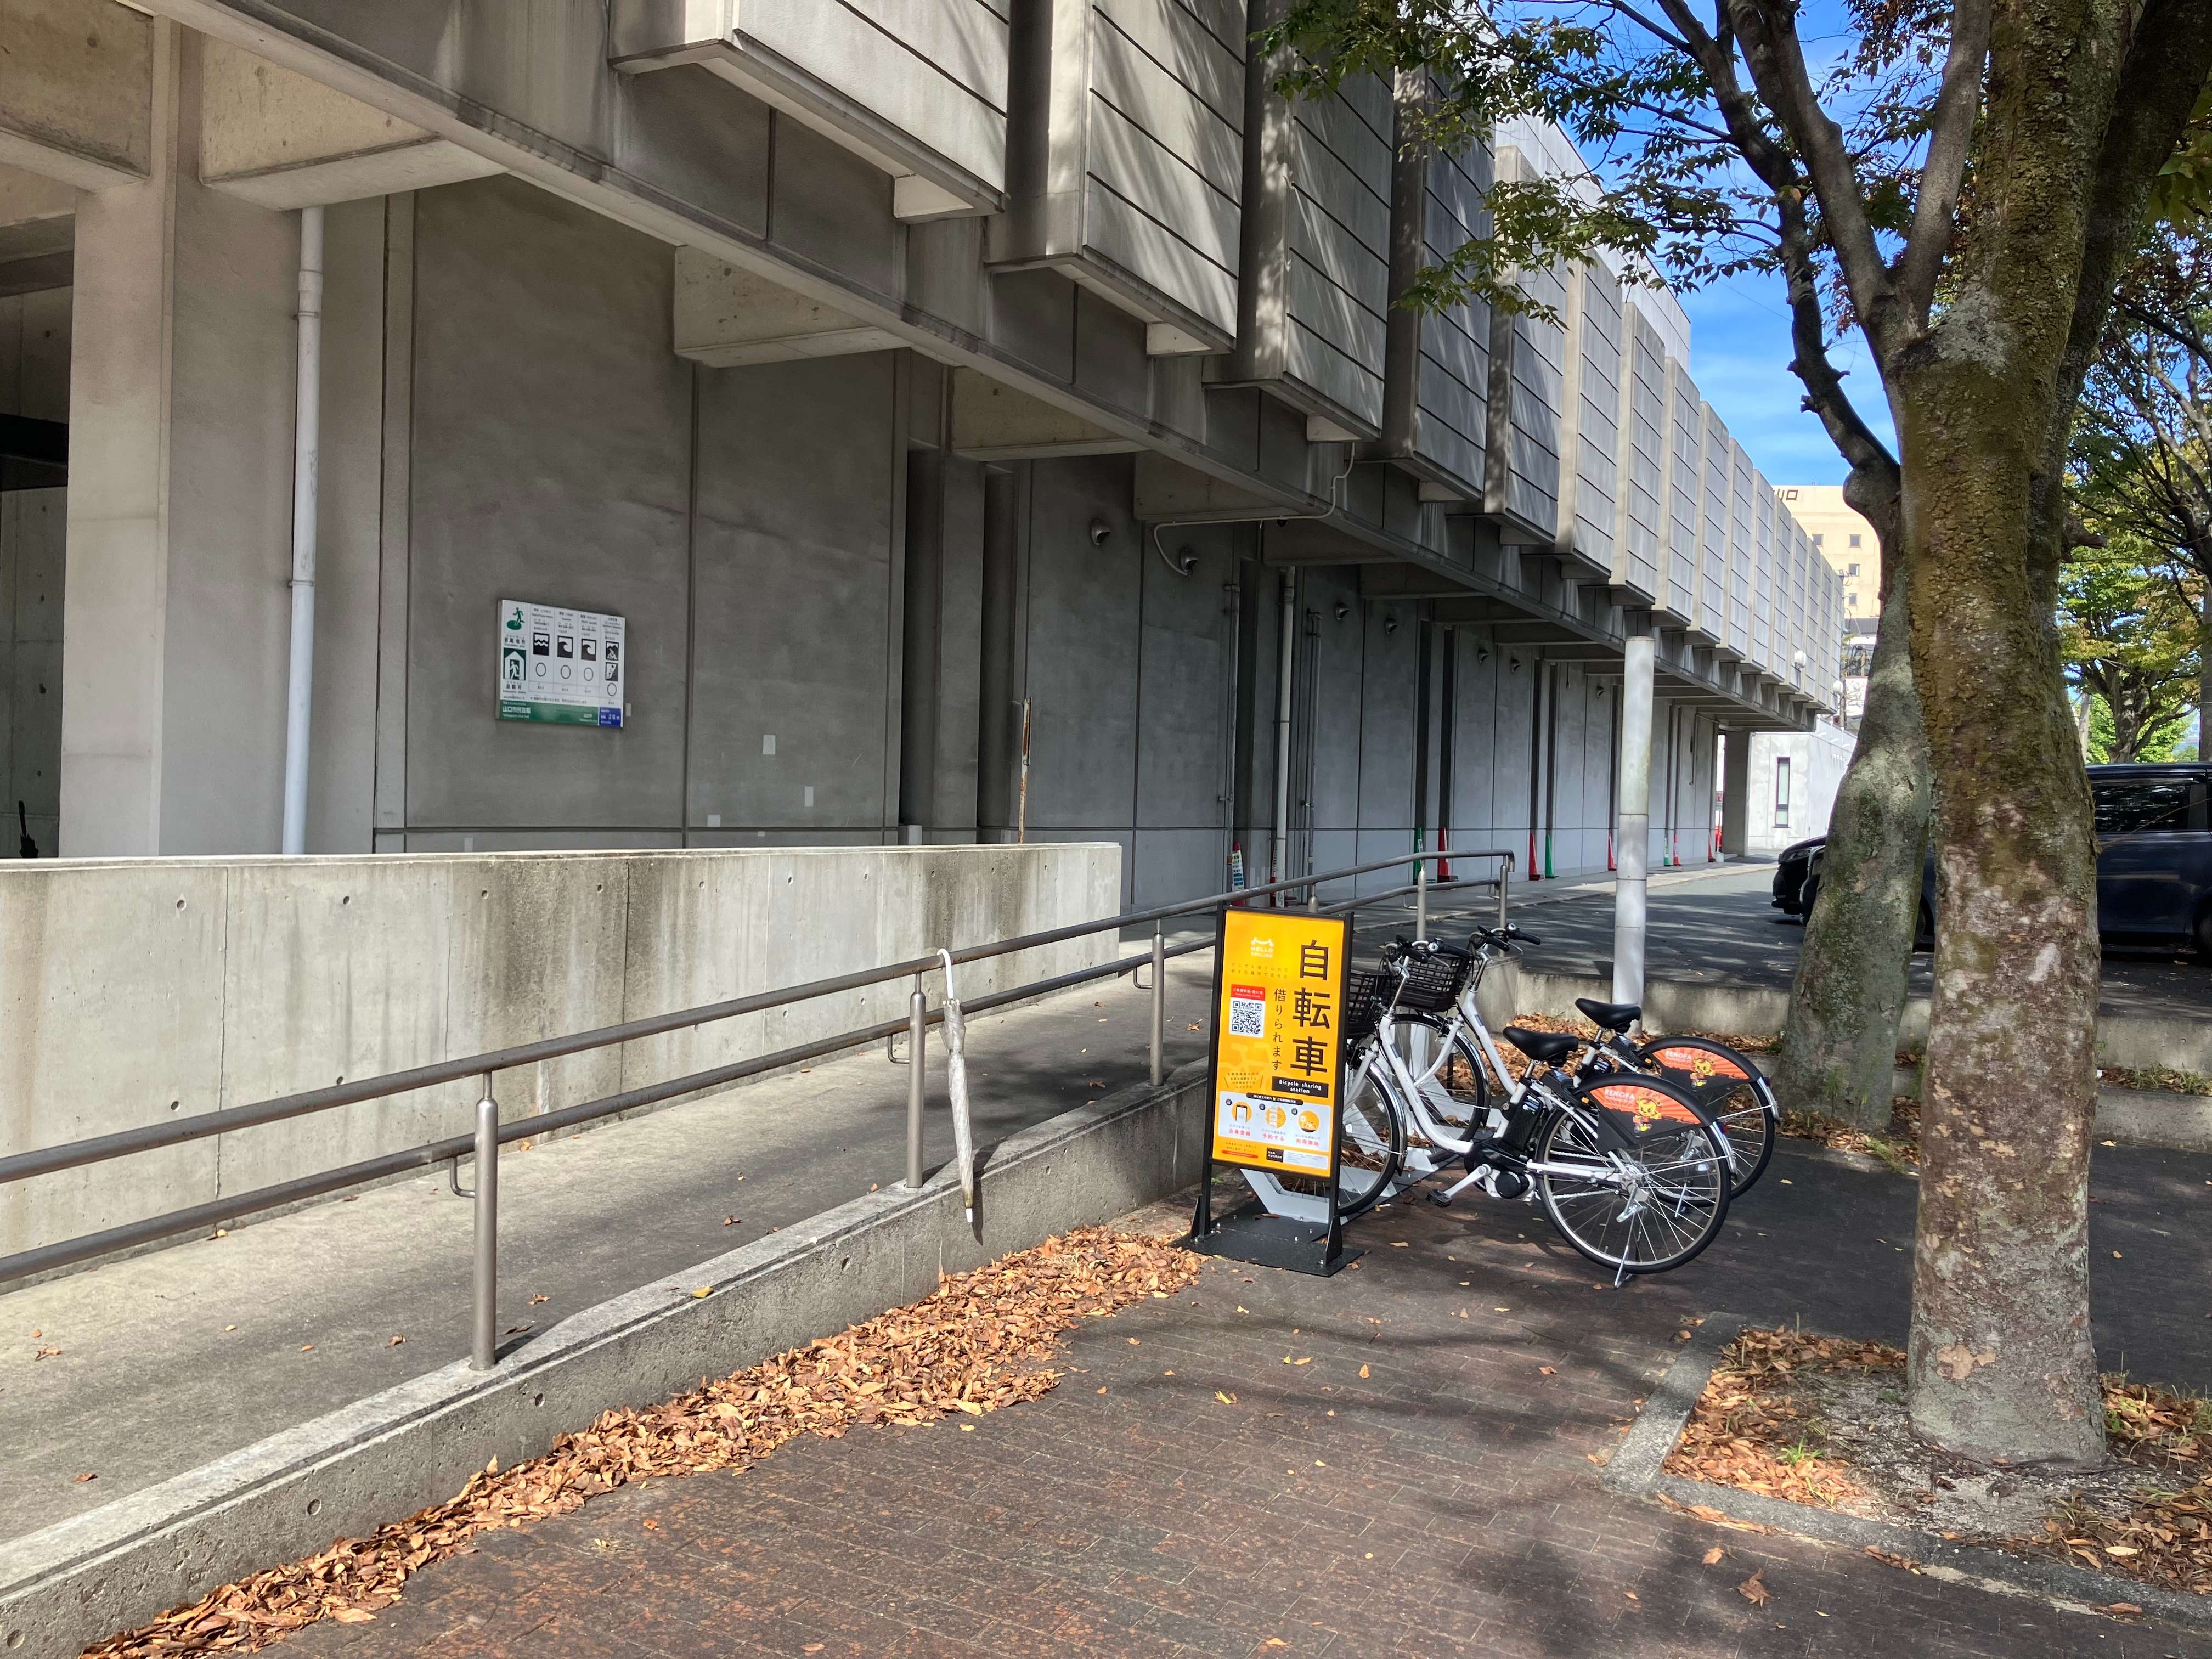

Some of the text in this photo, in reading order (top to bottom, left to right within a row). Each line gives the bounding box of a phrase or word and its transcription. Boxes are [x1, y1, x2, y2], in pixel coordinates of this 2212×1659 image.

[1290, 940, 1331, 1076] 自転車
[1272, 988, 1286, 1070] 借りられます
[1666, 1050, 1692, 1060] RENOFA
[1301, 1082, 1322, 1091] sharing
[1605, 1088, 1635, 1101] RENOFA
